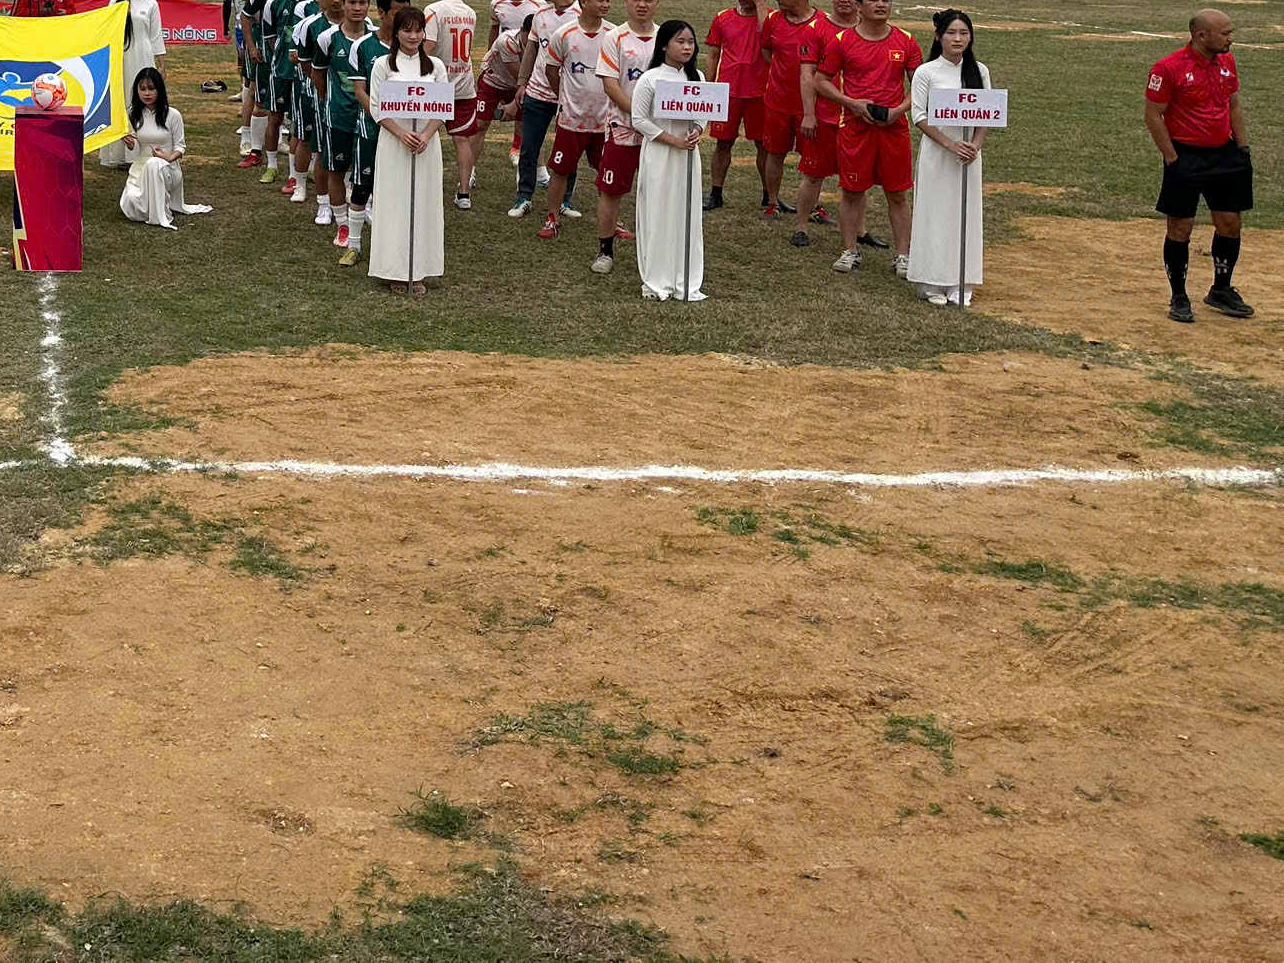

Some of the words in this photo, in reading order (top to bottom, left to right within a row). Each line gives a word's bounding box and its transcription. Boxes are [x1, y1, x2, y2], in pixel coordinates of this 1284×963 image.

[173, 25, 216, 41] NÔNG
[449, 28, 473, 62] 10
[407, 86, 425, 96] FC
[683, 85, 700, 95] FC
[959, 93, 977, 103] FC
[423, 100, 453, 113] NÔNG
[661, 99, 683, 111] LIÊN
[686, 100, 713, 113] QUÂN
[716, 103, 721, 113] 1
[934, 107, 958, 119] LIÊN
[961, 107, 990, 120] QUÂN
[993, 110, 1001, 120] 2
[554, 150, 563, 164] 8
